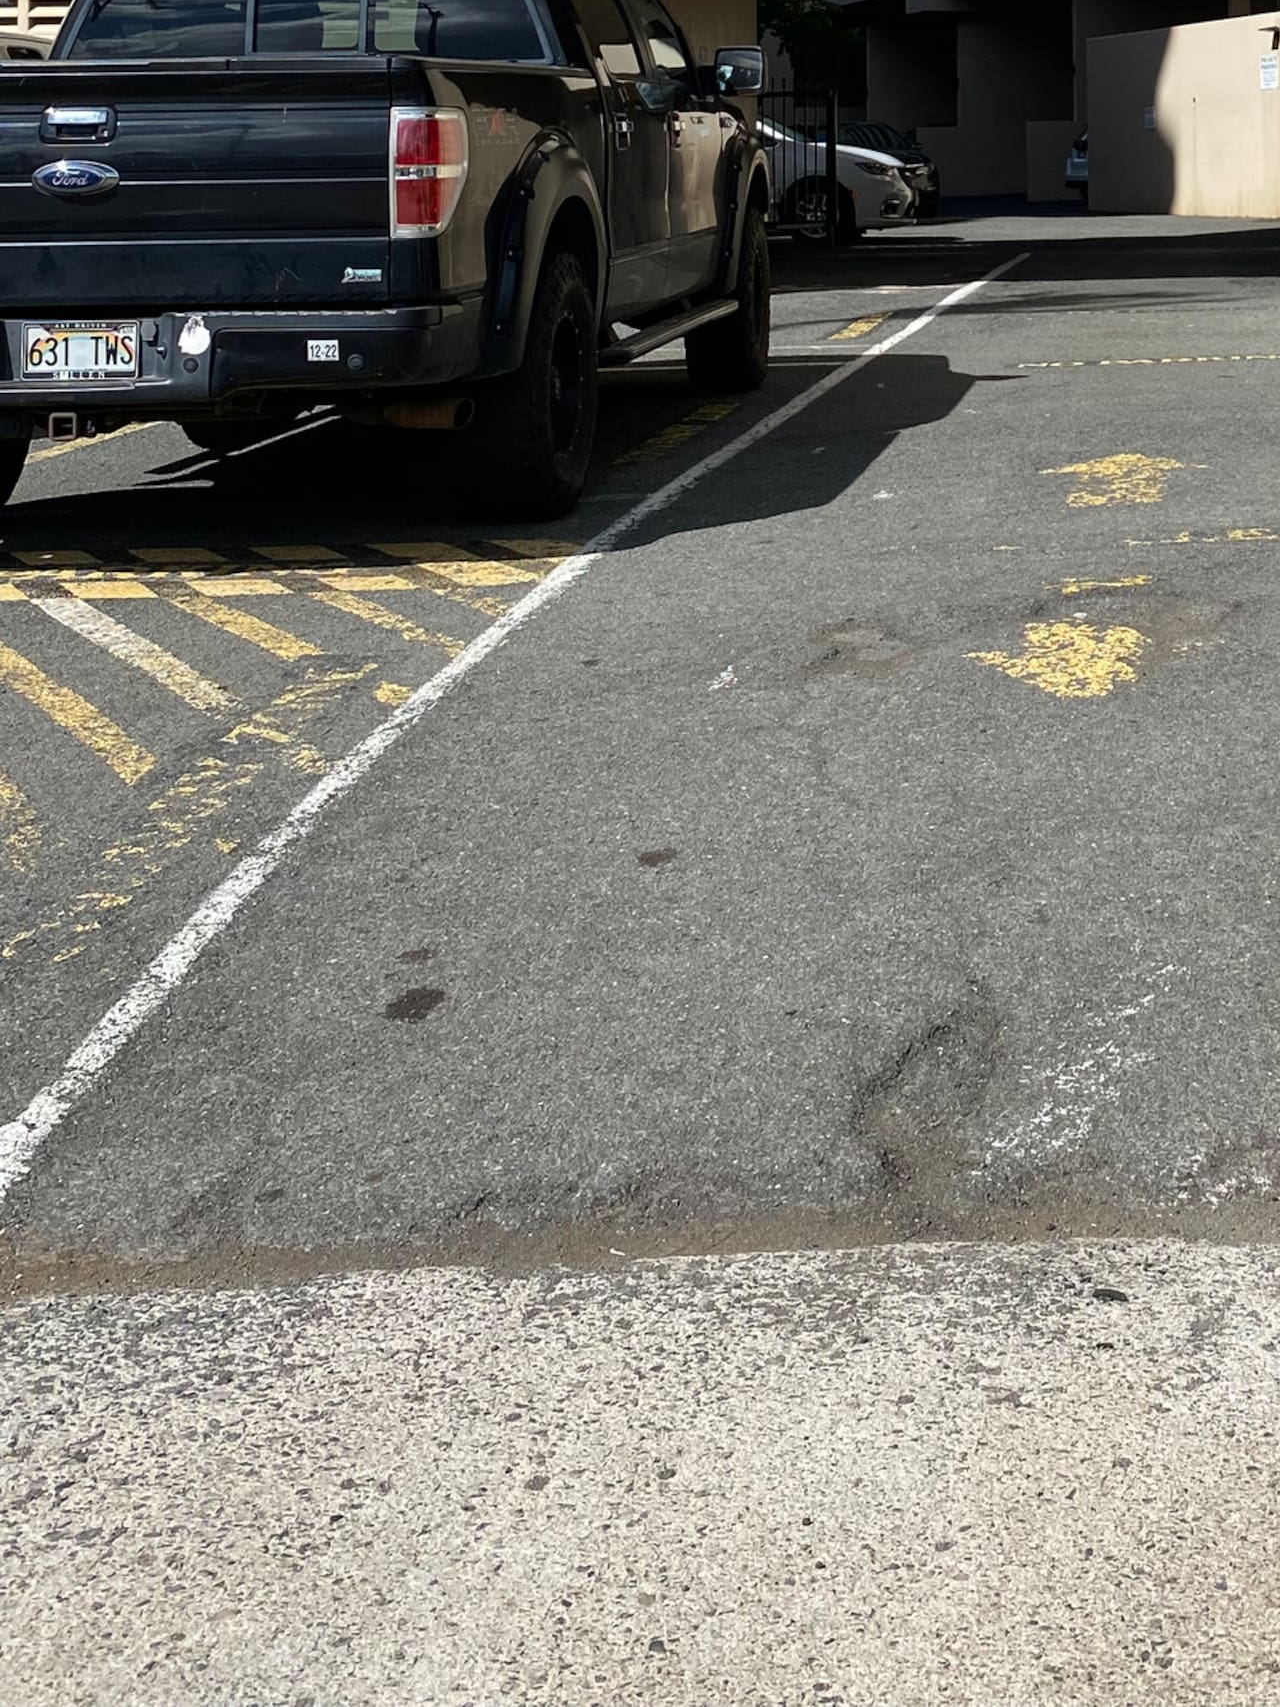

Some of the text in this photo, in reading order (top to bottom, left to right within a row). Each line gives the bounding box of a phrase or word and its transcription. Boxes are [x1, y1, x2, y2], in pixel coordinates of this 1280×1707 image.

[52, 170, 89, 186] Ford
[29, 336, 134, 366] 631 TWS
